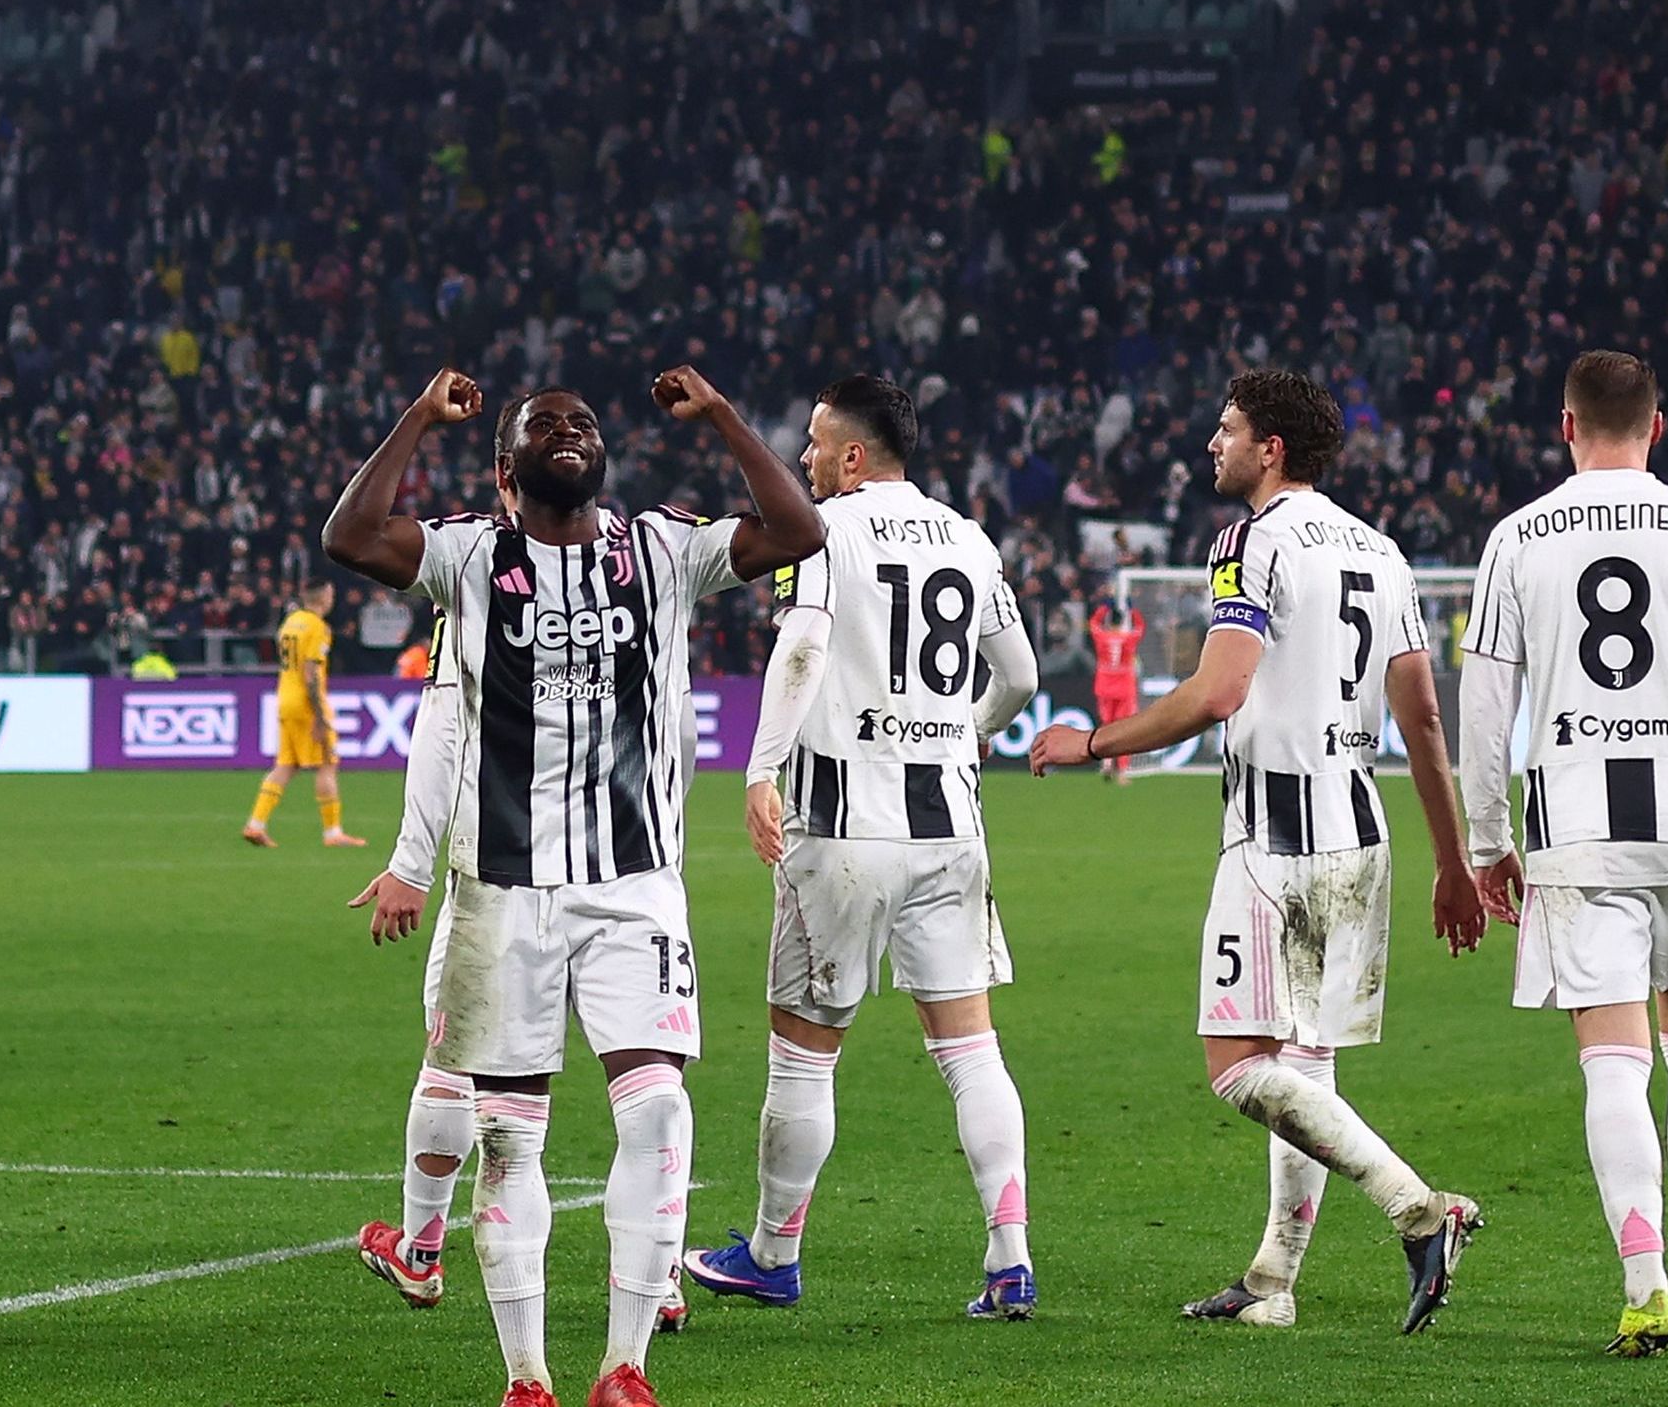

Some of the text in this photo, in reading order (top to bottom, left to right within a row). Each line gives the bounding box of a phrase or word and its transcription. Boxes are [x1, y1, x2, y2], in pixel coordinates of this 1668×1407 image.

[502, 601, 634, 654] Jeep
[877, 564, 974, 696] 18
[1339, 570, 1374, 702] 5
[1577, 556, 1654, 690] 8
[532, 677, 615, 705] Detroit
[549, 664, 595, 681] VISIT
[651, 936, 694, 998] 13
[1215, 934, 1242, 988] 5
